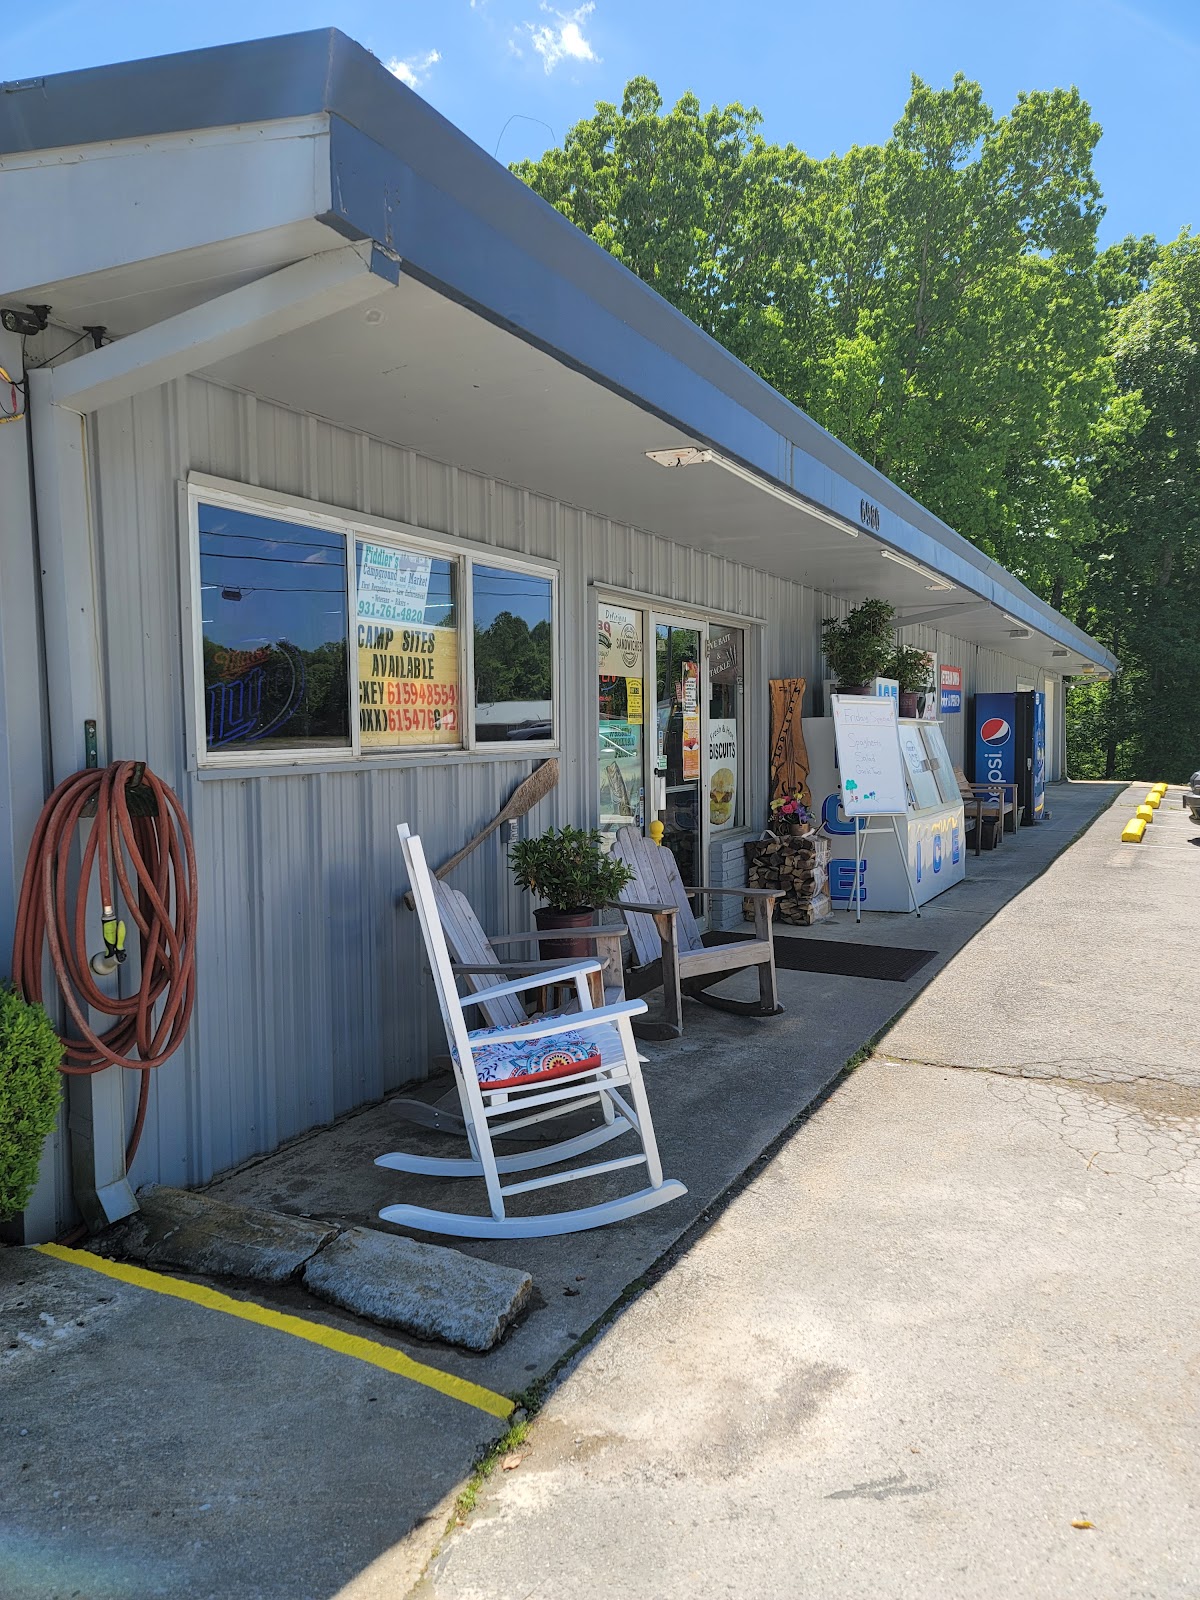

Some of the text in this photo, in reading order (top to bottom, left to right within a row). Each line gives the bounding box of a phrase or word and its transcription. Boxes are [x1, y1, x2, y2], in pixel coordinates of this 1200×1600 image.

[364, 545, 399, 569] Fiddler's
[363, 562, 398, 581] Campground
[407, 572, 428, 588] Market
[358, 600, 423, 624] 931-761-4820
[357, 624, 435, 654] CAMP SITES
[616, 638, 643, 652] SANDWICHES
[718, 633, 731, 646] BAIT
[716, 651, 722, 660] &
[372, 653, 435, 680] AVAILABLE
[709, 660, 731, 677] TACKLE
[709, 724, 721, 742] Fresh
[722, 724, 726, 733] &
[709, 741, 736, 760] BISCUITS
[916, 826, 960, 884] ICE
